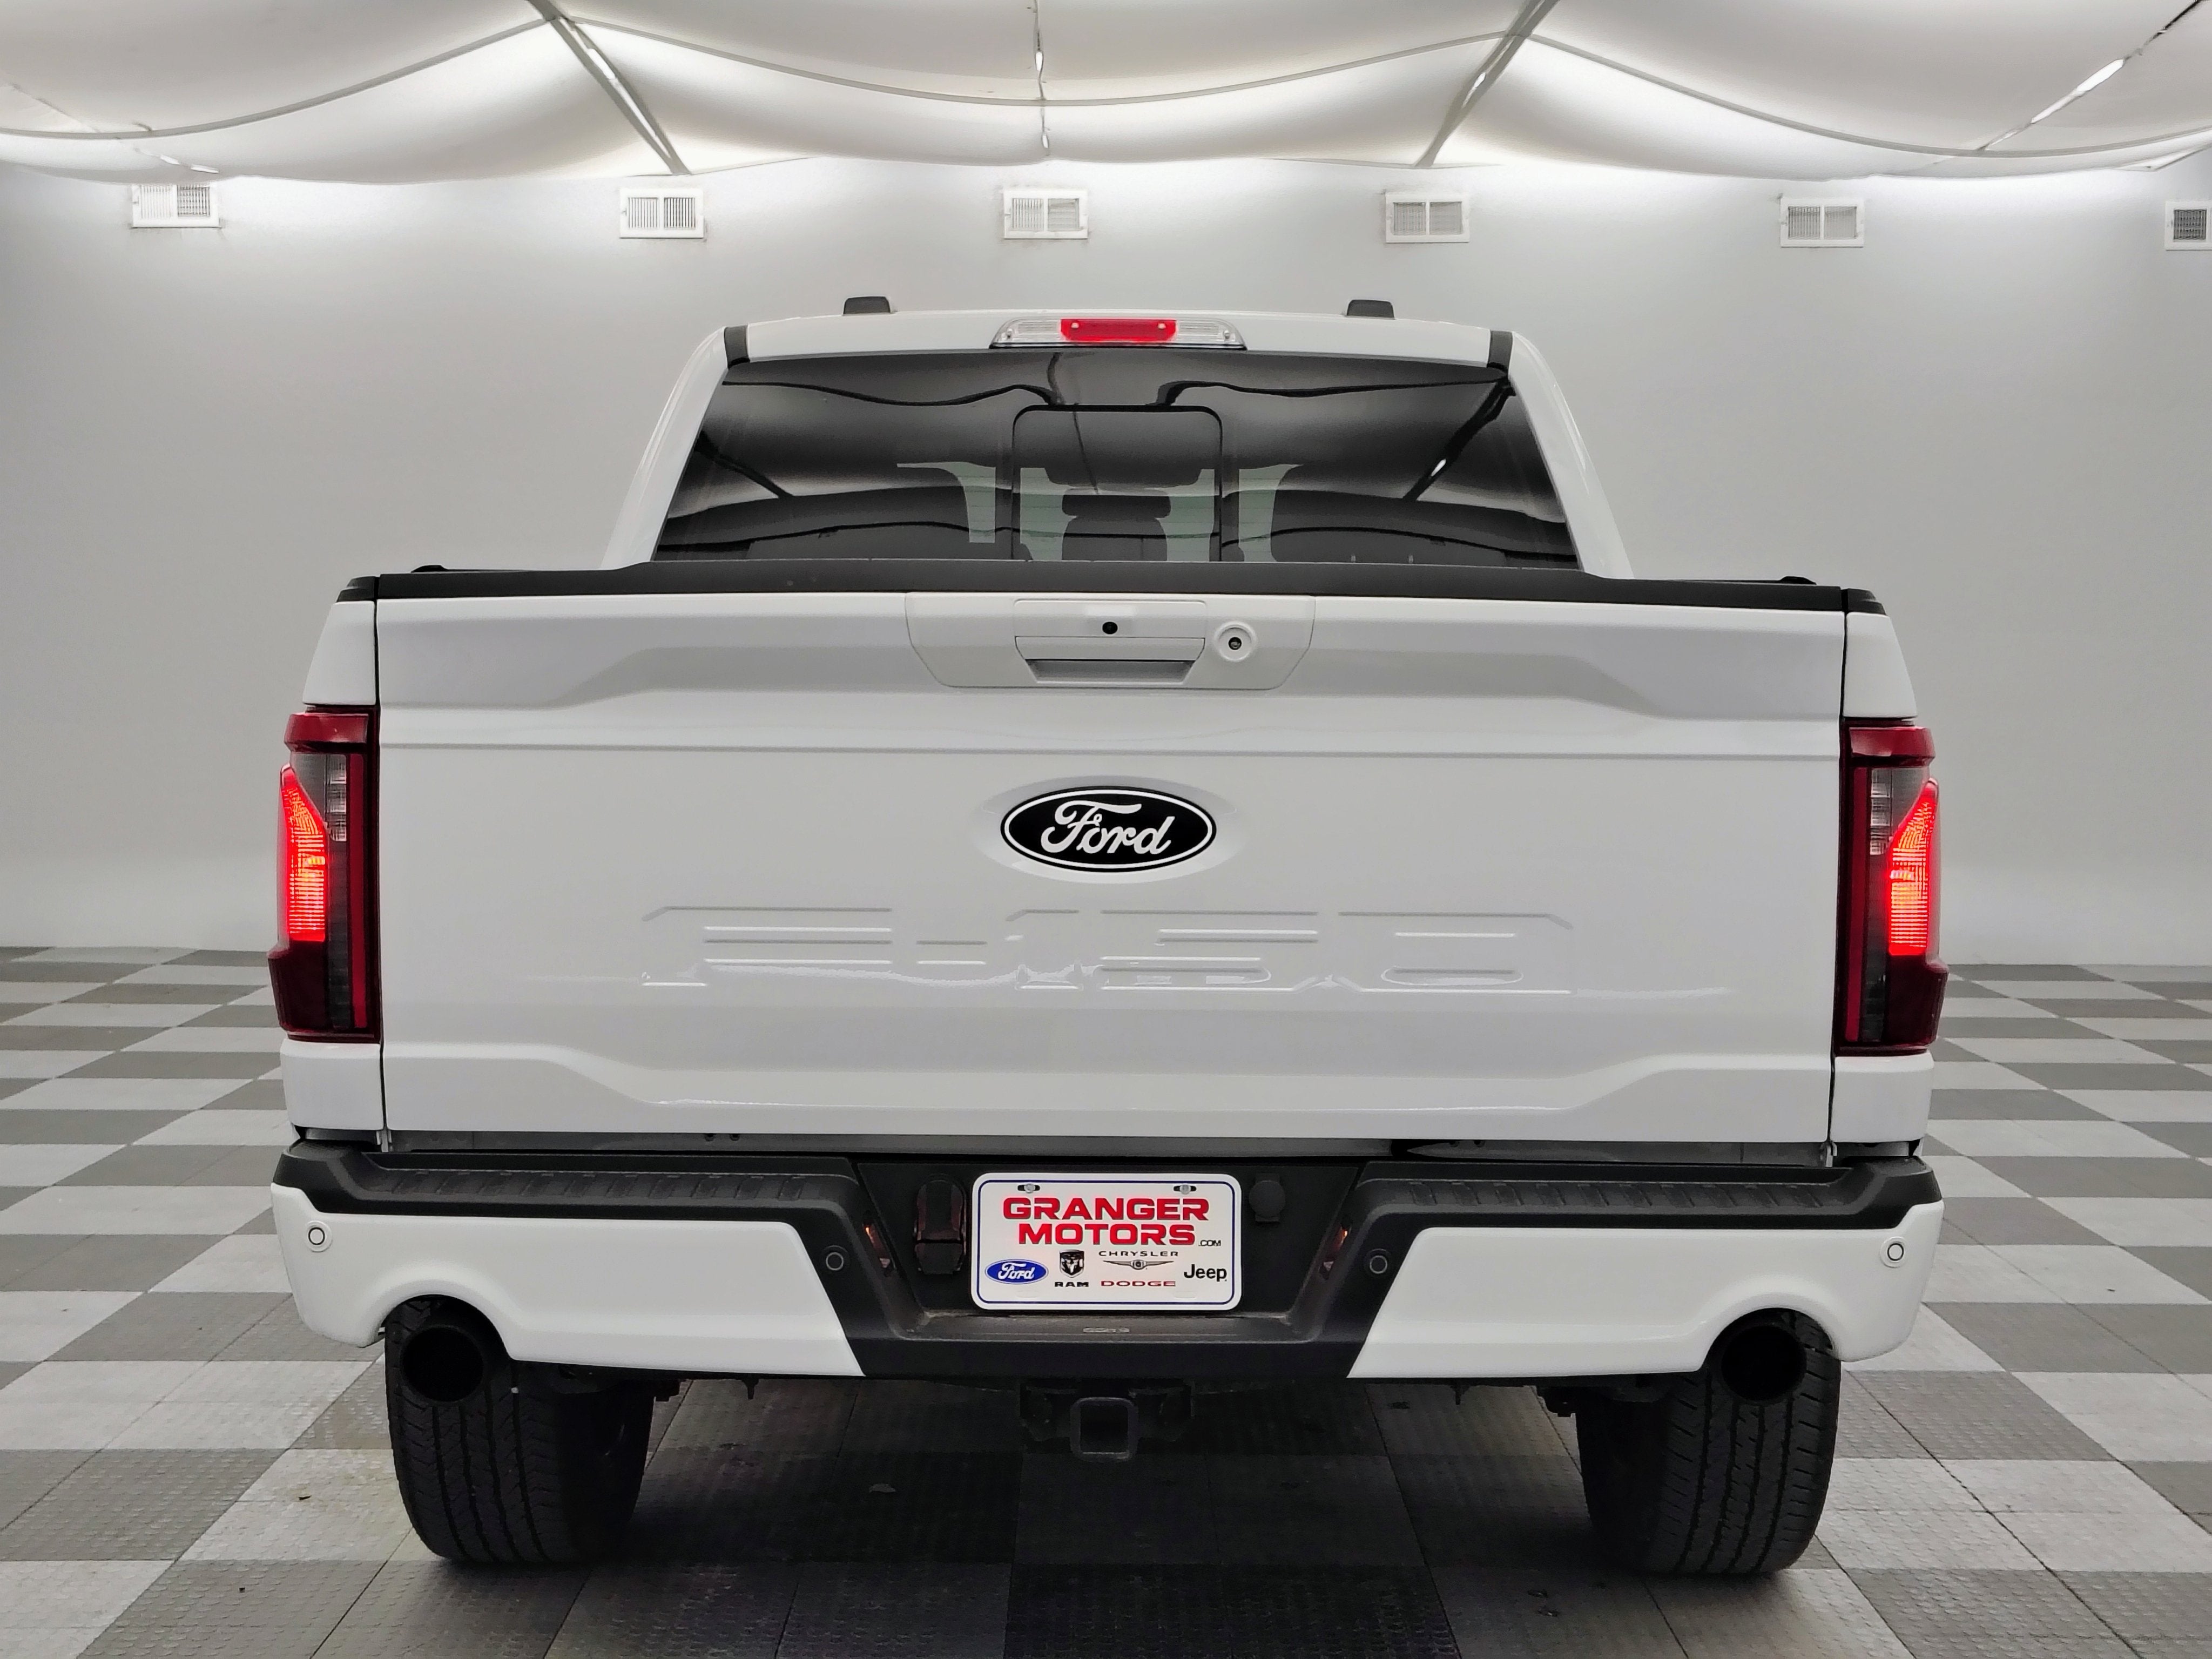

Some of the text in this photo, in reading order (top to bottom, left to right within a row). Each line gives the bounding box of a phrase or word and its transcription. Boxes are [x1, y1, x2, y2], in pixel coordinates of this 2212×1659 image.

[1040, 800, 1175, 854] Ford
[1003, 1197, 1209, 1220] GRANGER
[1019, 1223, 1196, 1245] MOTORS
[997, 1262, 1036, 1279] Ford
[1184, 1264, 1227, 1282] Jeep
